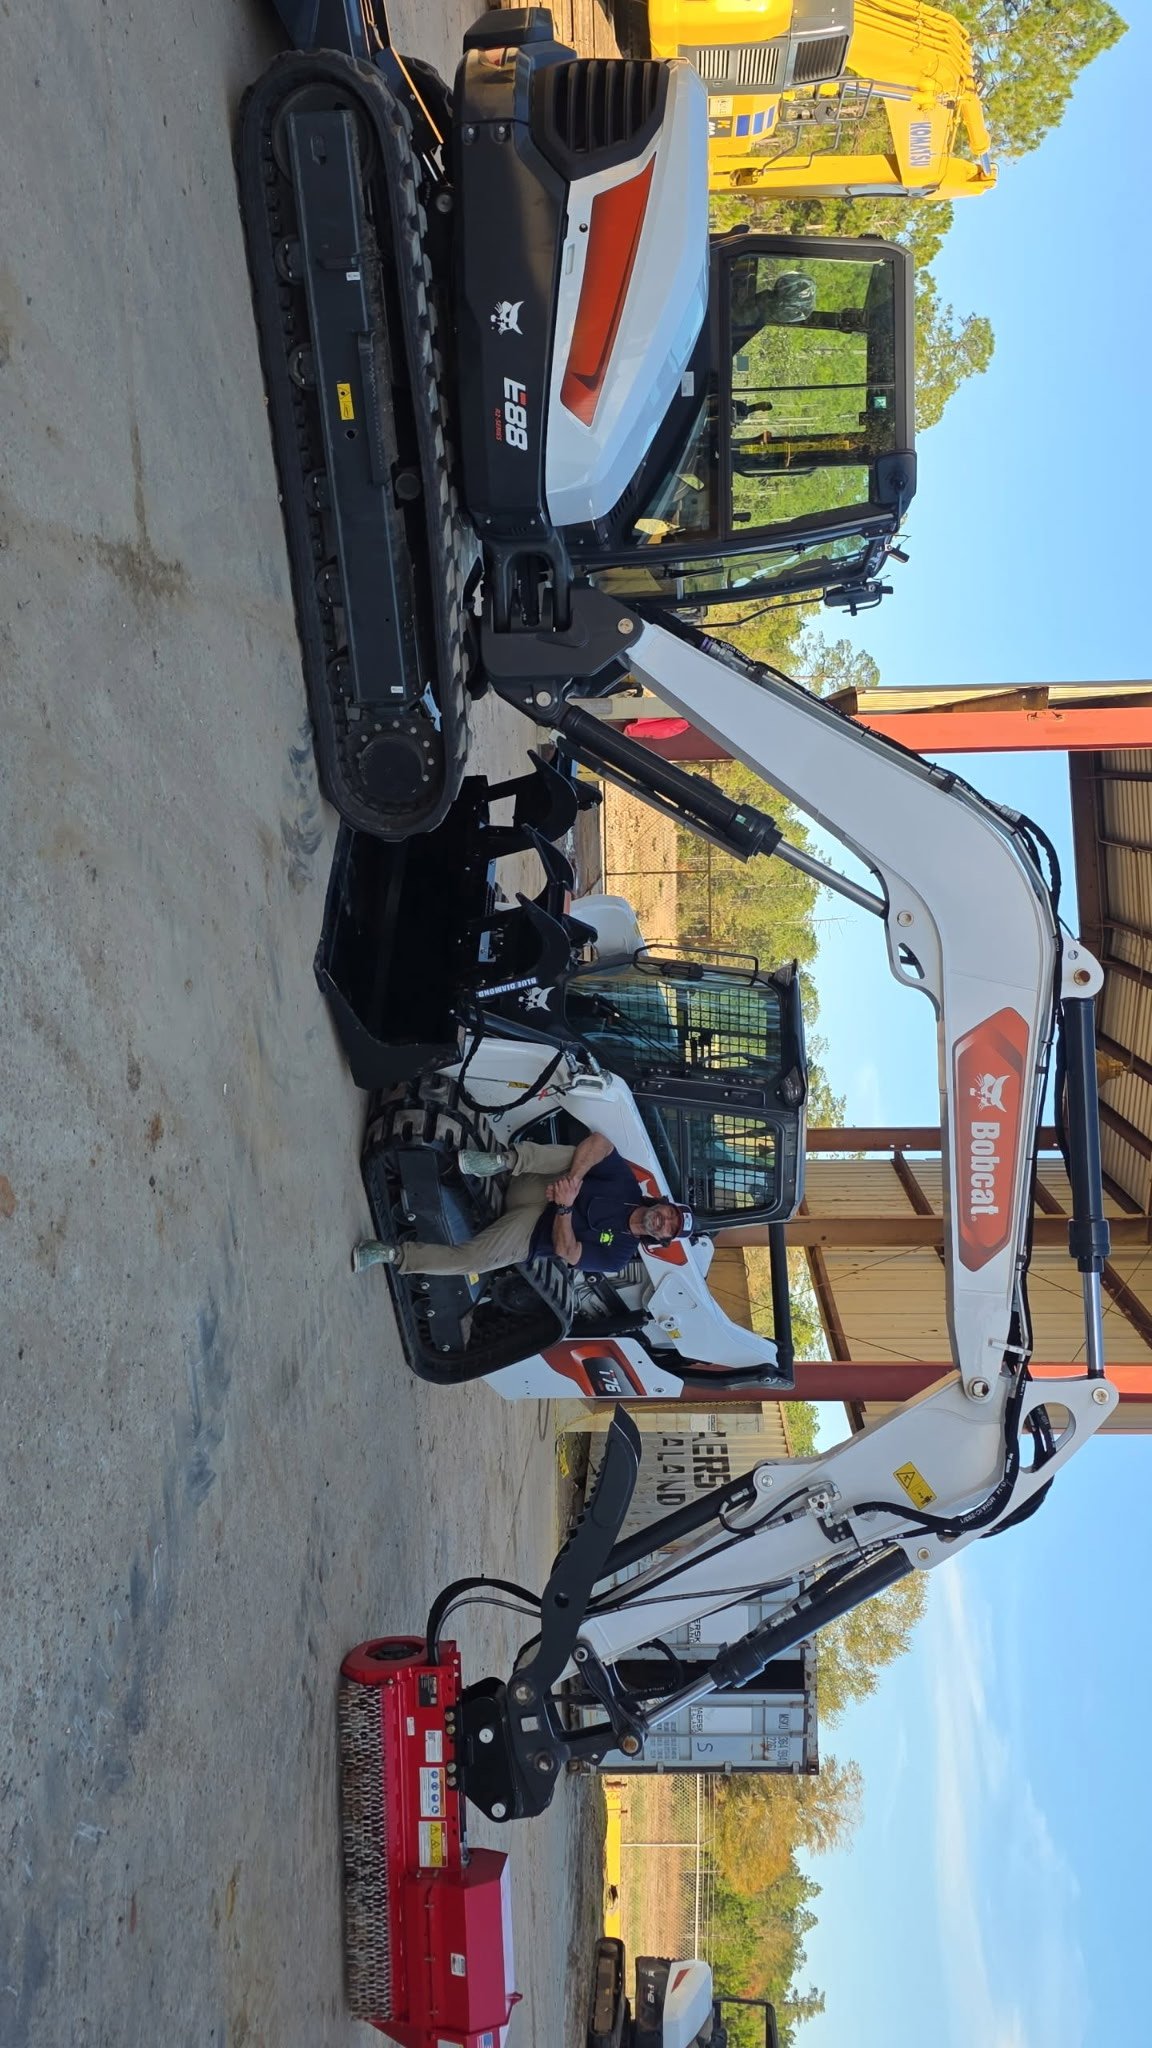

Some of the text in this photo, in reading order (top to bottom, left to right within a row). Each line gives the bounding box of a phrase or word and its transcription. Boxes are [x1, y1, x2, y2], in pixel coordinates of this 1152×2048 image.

[910, 121, 933, 167] KOMATSU
[494, 408, 502, 441] R2-SERIES
[504, 377, 528, 451] E88
[477, 976, 537, 998] BLUE DIAMOND
[970, 1121, 1000, 1215] Bobcat
[598, 1370, 622, 1392] T76
[656, 1432, 686, 1506] ALAND
